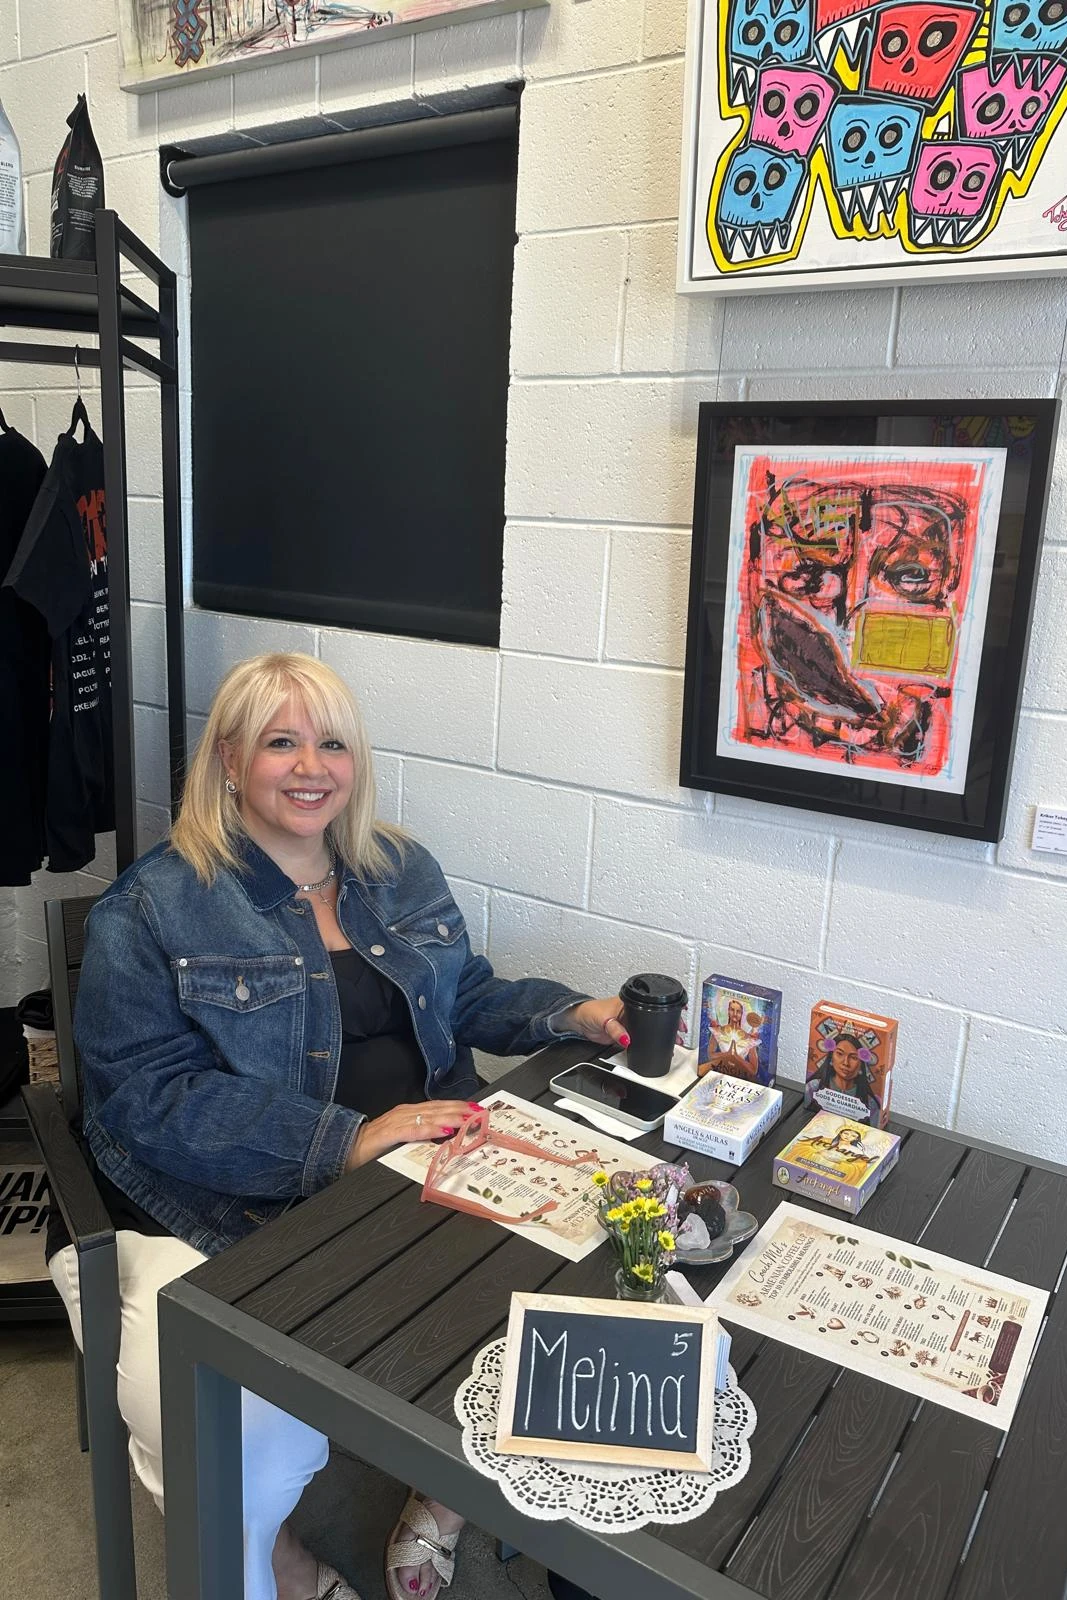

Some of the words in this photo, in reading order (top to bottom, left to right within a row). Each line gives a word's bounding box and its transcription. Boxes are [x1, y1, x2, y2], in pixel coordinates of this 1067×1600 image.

[714, 1087, 753, 1104] AURAS
[719, 1080, 762, 1097] ANGELS
[815, 1092, 831, 1101] GODS
[836, 1099, 869, 1114] GUARDIANS
[673, 1124, 699, 1137] ANGELS
[704, 1133, 729, 1146] AURAS
[797, 1136, 880, 1163] Archangel
[748, 1259, 773, 1284] Coach
[759, 1262, 785, 1296] ARMENIAN
[783, 1245, 800, 1266] COFFEE
[798, 1233, 808, 1246] CUP
[768, 1287, 778, 1300] TOP
[671, 1332, 694, 1357] 5
[524, 1327, 688, 1439] Melina
